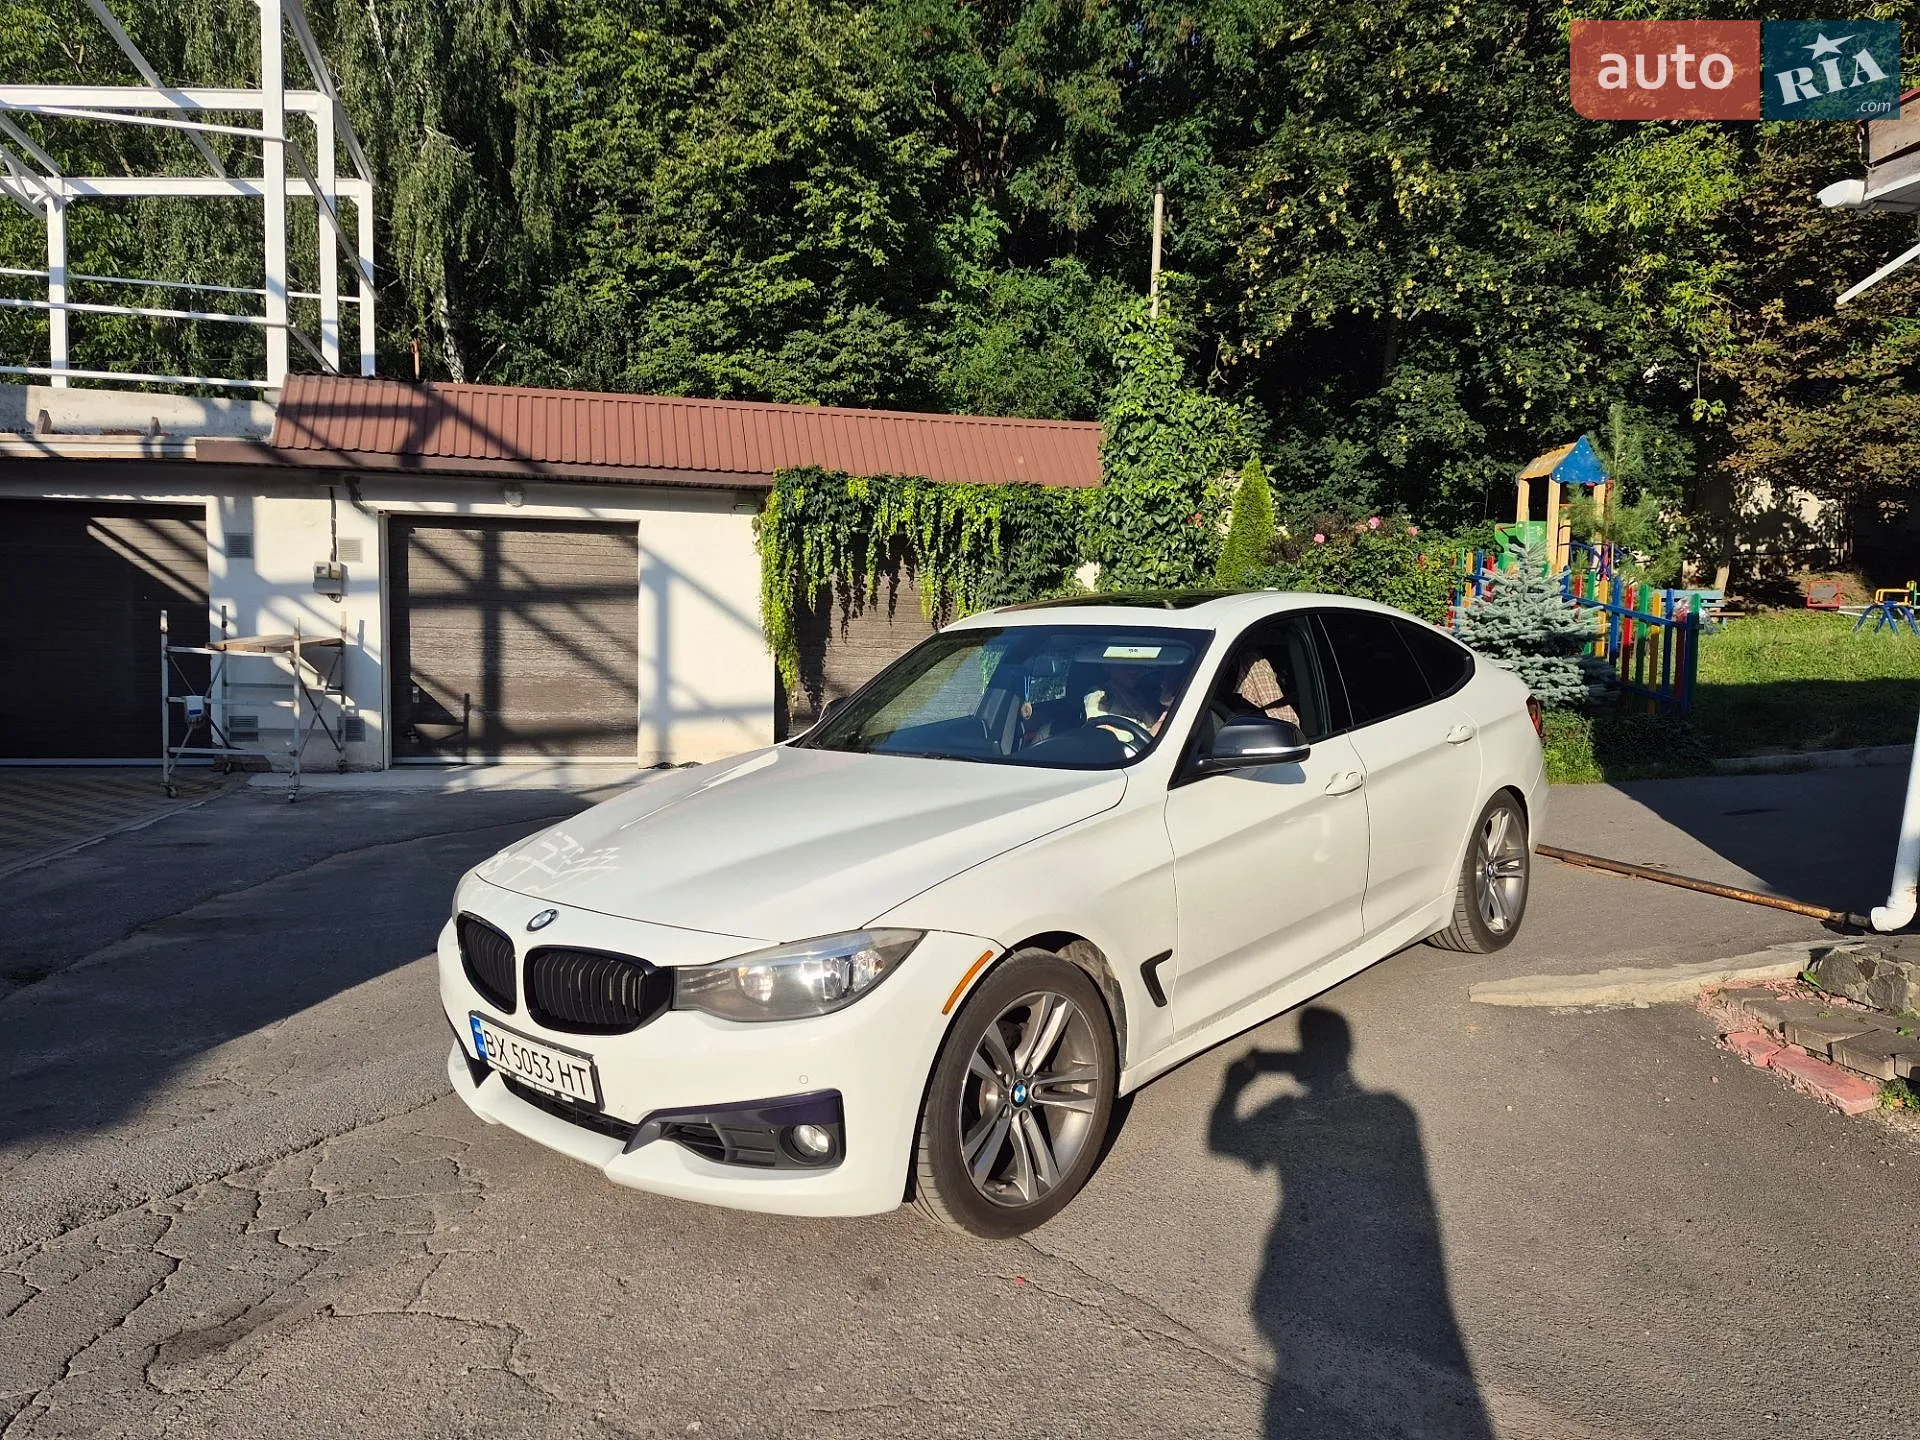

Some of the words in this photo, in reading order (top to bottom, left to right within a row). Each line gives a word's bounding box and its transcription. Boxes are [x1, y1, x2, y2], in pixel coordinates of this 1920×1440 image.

[483, 1029, 510, 1066] BX
[511, 1043, 555, 1084] 5053
[557, 1060, 587, 1096] HT
